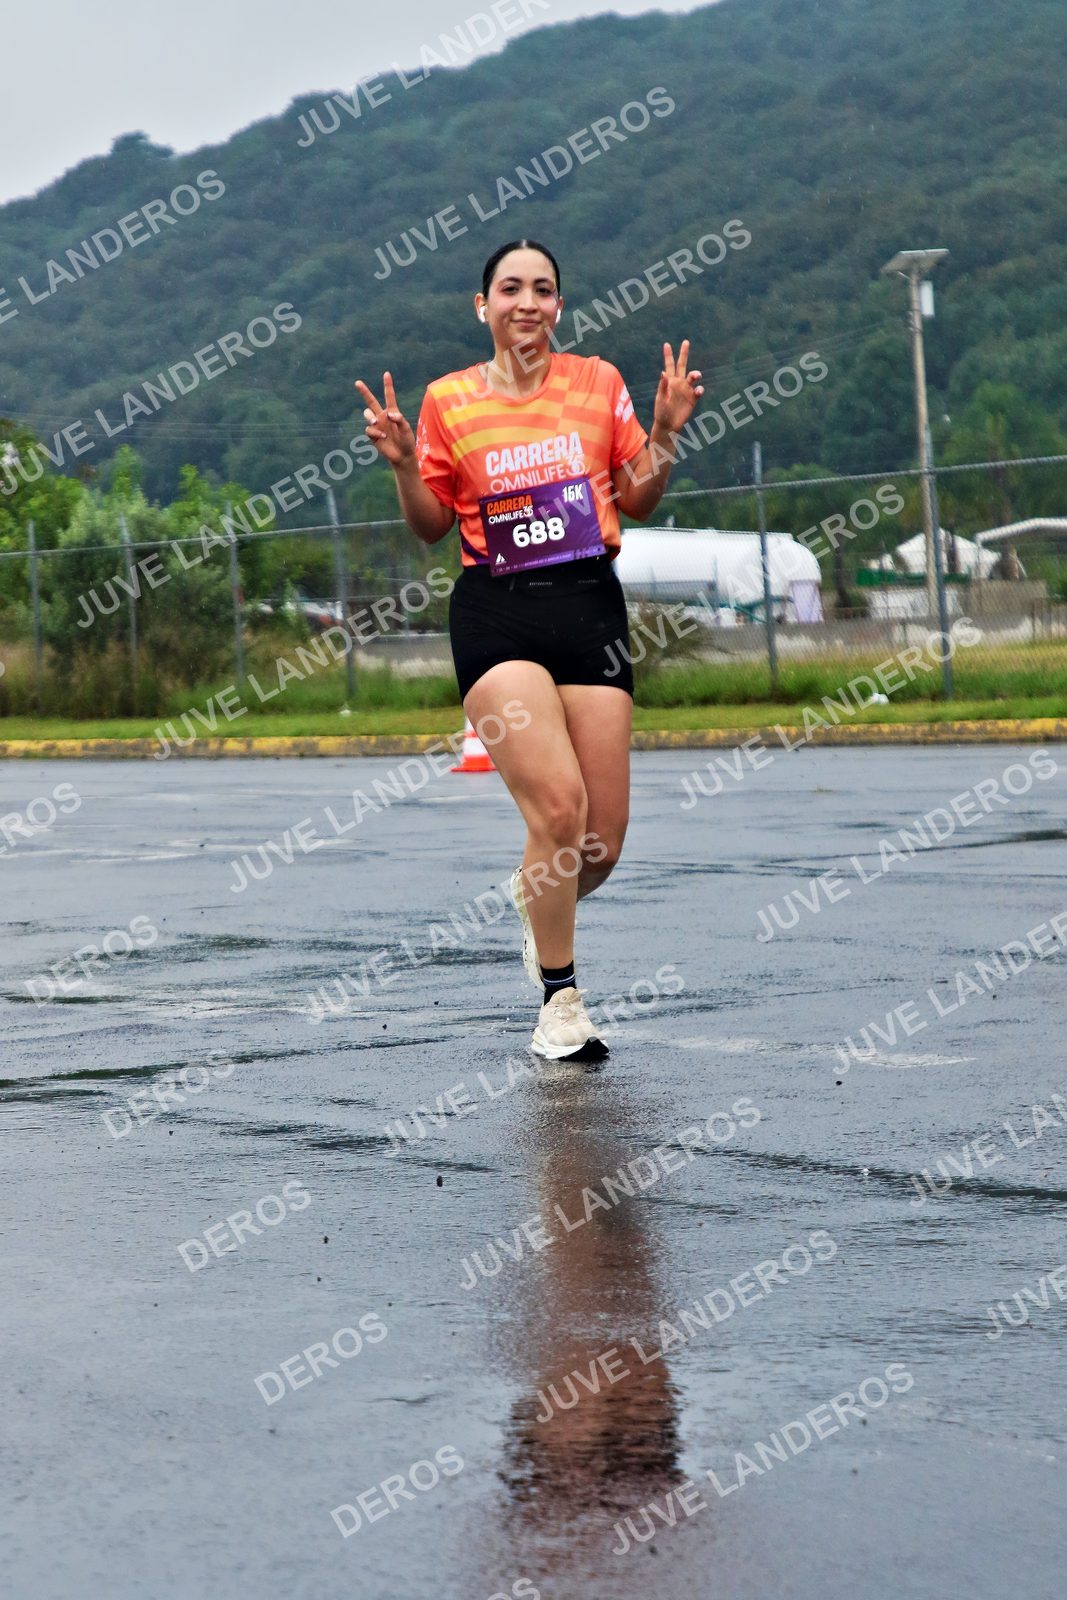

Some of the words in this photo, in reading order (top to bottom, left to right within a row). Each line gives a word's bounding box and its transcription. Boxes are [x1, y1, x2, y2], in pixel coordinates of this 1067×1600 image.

[486, 432, 584, 477] CARRERA
[490, 464, 566, 494] OMNILIFE
[487, 495, 533, 516] CARRERA
[512, 517, 566, 548] 688
